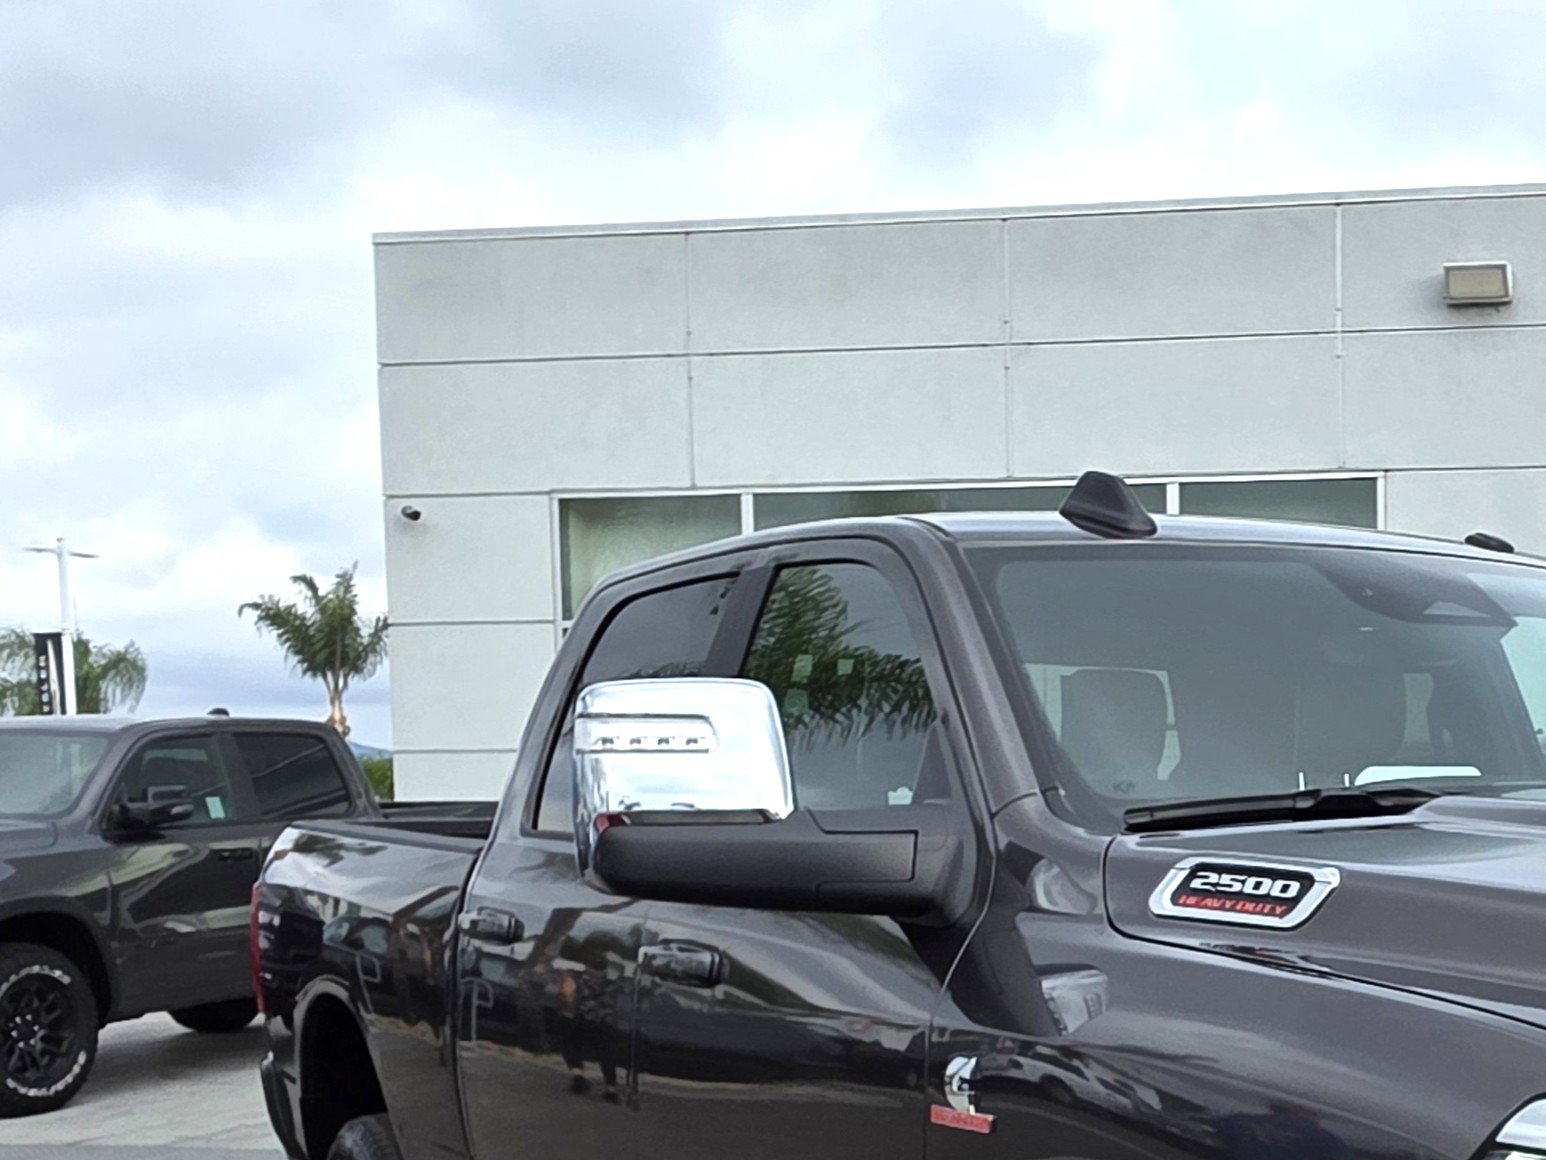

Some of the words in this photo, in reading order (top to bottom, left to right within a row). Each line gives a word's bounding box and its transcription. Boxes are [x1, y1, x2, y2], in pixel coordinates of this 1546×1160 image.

[1190, 871, 1300, 898] 2500
[1179, 895, 1235, 909] HEAVY
[1237, 901, 1287, 914] DUTY
